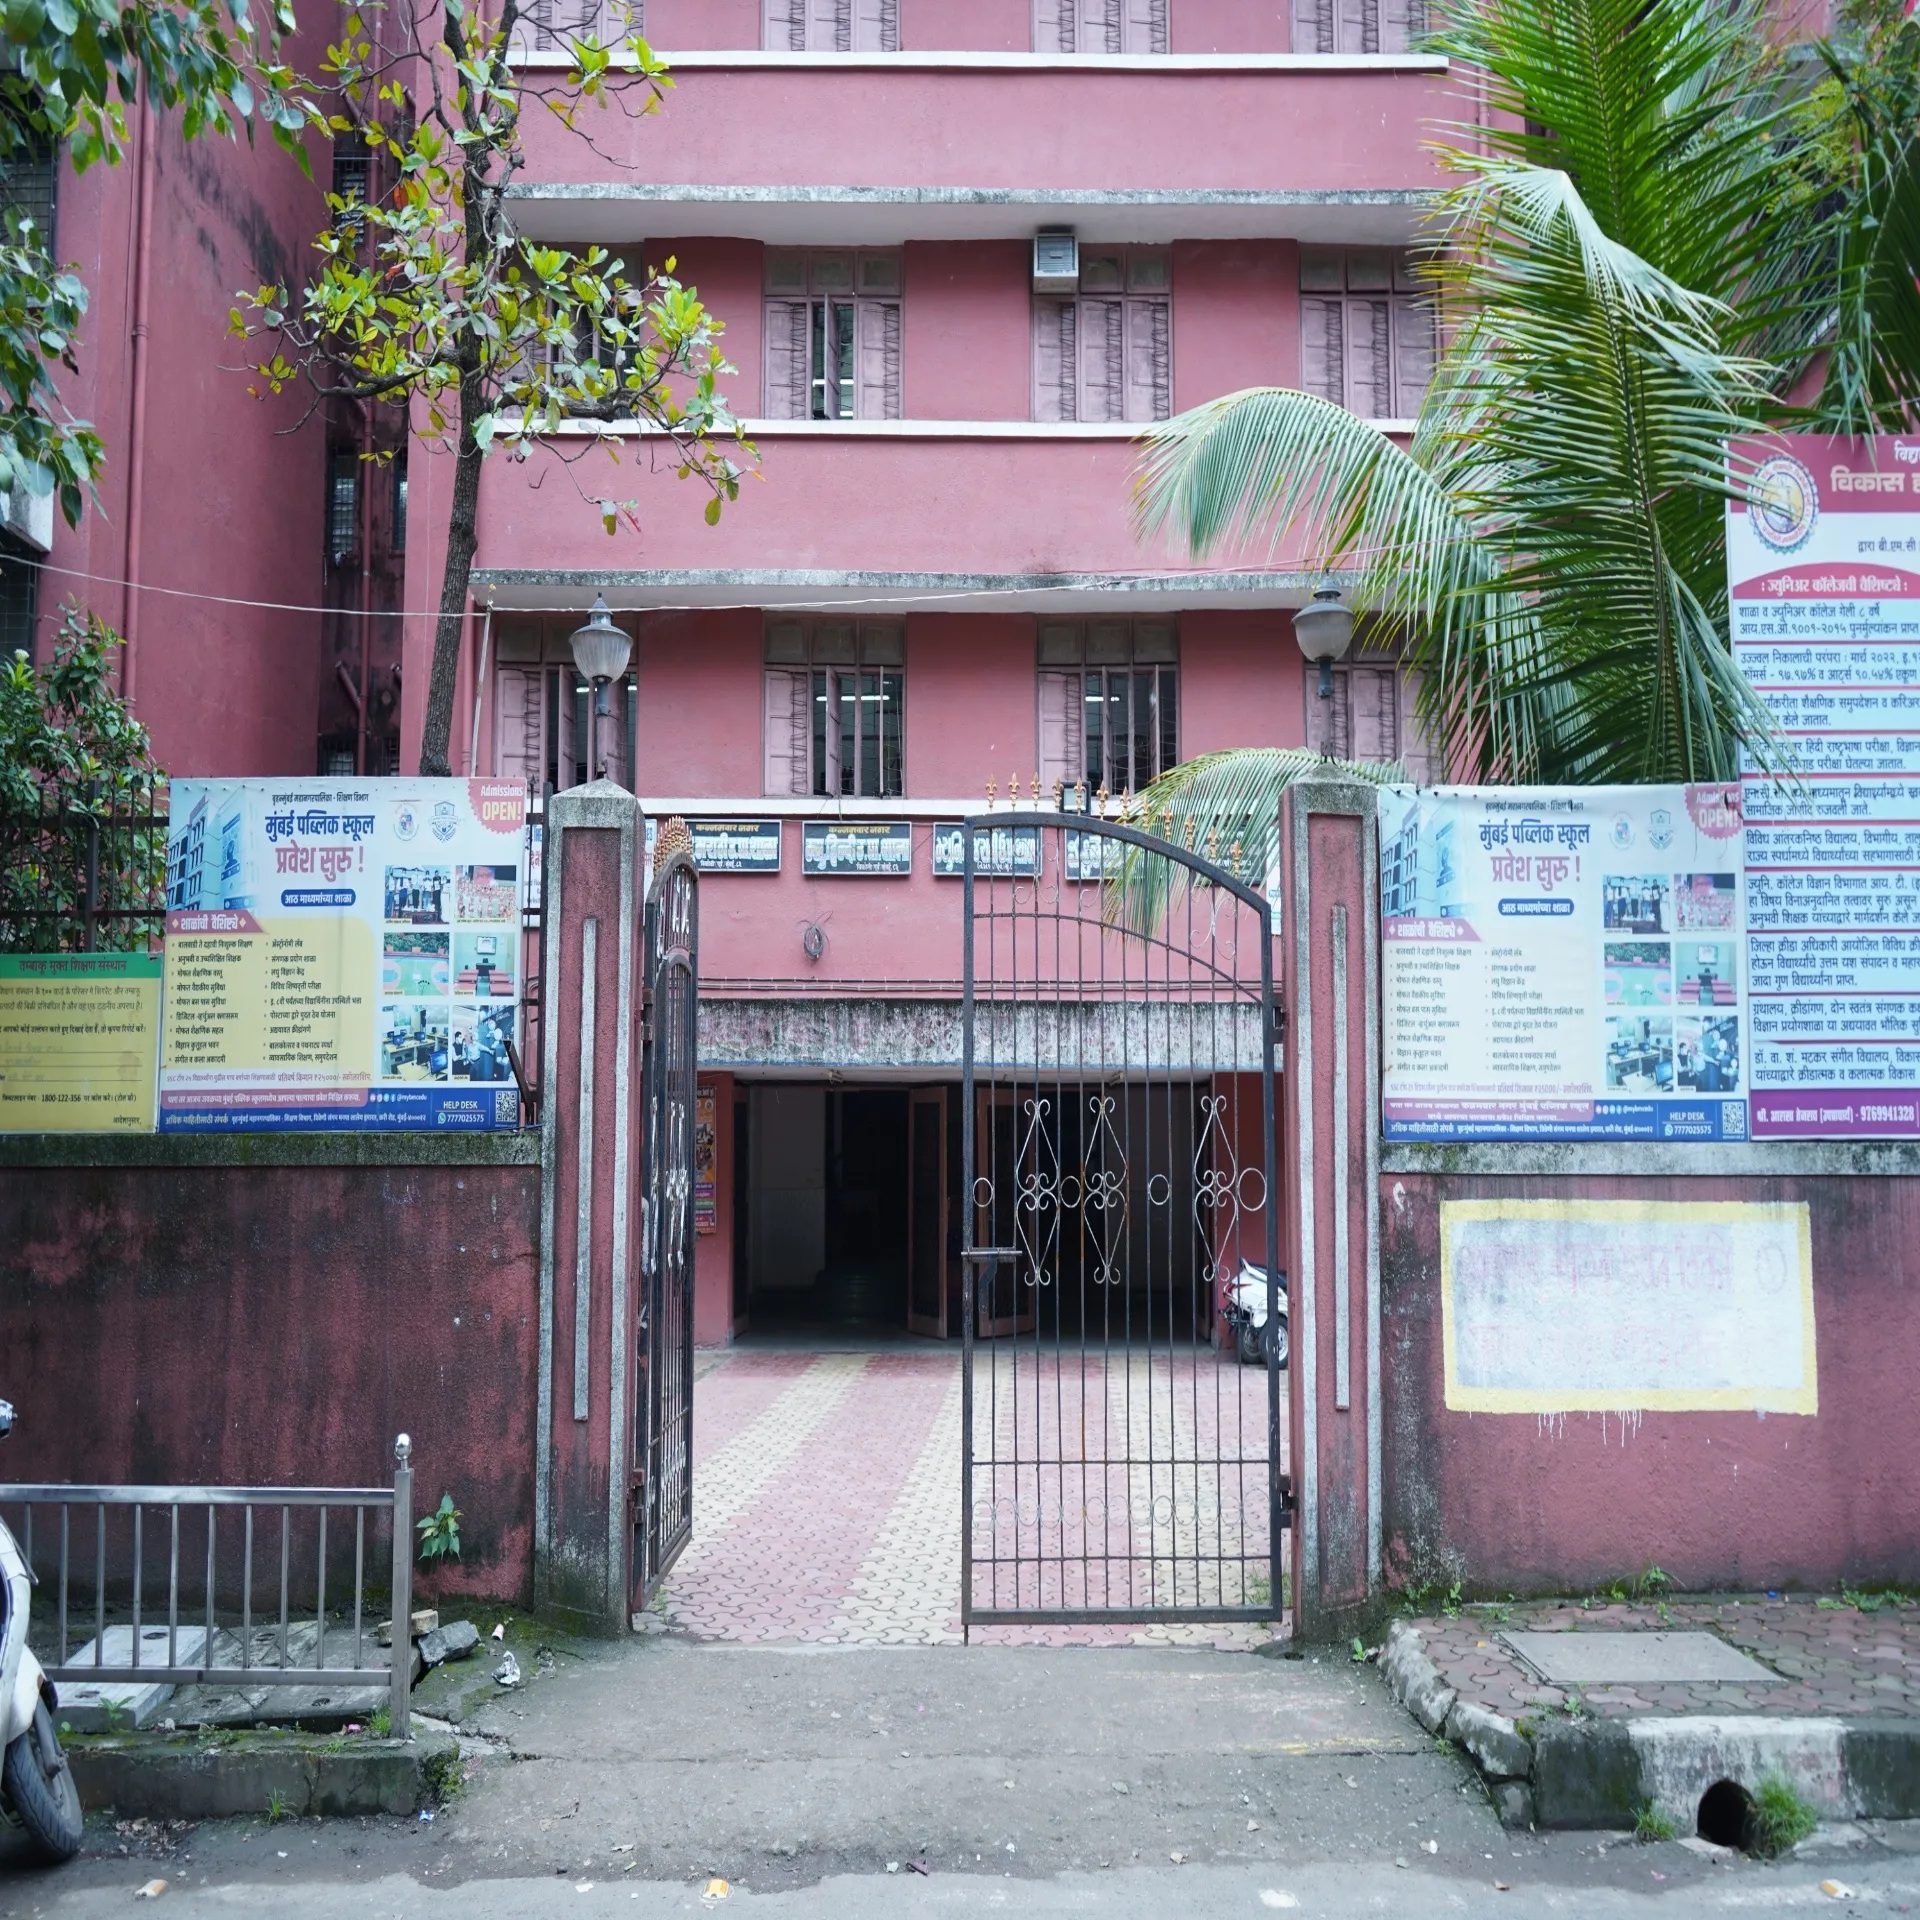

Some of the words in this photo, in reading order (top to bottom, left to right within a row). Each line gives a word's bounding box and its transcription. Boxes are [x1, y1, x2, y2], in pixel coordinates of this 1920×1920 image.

[1831, 465, 1905, 492] विकास
[1858, 540, 1875, 552] द्वारा
[1768, 575, 1809, 596] ज्युनिअर
[1739, 607, 1758, 617] शाळा
[1772, 603, 1806, 621] ज्युनिअर
[1810, 603, 1835, 617] कॉलेज
[1840, 603, 1855, 617] गेली
[1868, 602, 1880, 617] वर्षे
[1901, 623, 1919, 633] प्राप्त
[1773, 649, 1812, 663] निकालाची
[1816, 650, 1840, 662] परंपरा
[1851, 648, 1866, 662] मार्च
[1896, 669, 1916, 684] एकूण
[1802, 694, 1835, 709] शैक्षणिक
[1840, 694, 1878, 713] समुपदेशन
[1783, 712, 1799, 726] केले
[1802, 715, 1831, 726] जातात.
[1806, 738, 1823, 752] हिंदी
[1827, 742, 1862, 756] राष्ट्रभाषा
[1818, 756, 1841, 769] परीक्षा
[1845, 757, 1873, 769] घेतल्या
[1877, 759, 1906, 769] जातात.
[294, 793, 332, 802] महानगरपालिका
[337, 792, 352, 802] शिक्षण
[354, 792, 369, 802] विभाग
[481, 785, 523, 797] Admissions
[483, 802, 522, 820] OPEN!
[1745, 801, 1782, 815] सामाजिक
[1817, 801, 1851, 815] रुजवली
[1851, 801, 1871, 815] जाते.
[265, 810, 294, 842] मुंबई
[297, 810, 340, 835] पब्लिक
[342, 815, 375, 841] स्कूल
[1479, 819, 1508, 850] मुंबई
[1511, 819, 1554, 843] पब्लिक
[1557, 825, 1590, 850] स्कूल
[1747, 829, 1769, 844] विविध
[1773, 829, 1822, 844] आंतरकनिष्ठ
[275, 839, 316, 873] प्रवेश
[319, 847, 353, 882] सुरु
[359, 846, 363, 872] !
[1748, 850, 1767, 861] राज्य
[1863, 847, 1913, 862] सहभागासाठी
[1491, 848, 1532, 882] प्रवेश
[1535, 856, 1569, 891] सुरु
[1576, 856, 1580, 882] !
[1777, 875, 1803, 889] कॉलेज
[1807, 874, 1830, 889] विज्ञान
[1834, 874, 1867, 889] विभागात
[285, 895, 298, 904] आठ
[300, 892, 333, 904] माध्यमांच्या
[335, 894, 352, 903] शाळा
[1749, 895, 1757, 907] हा
[1761, 892, 1782, 906] विषय
[1786, 892, 1840, 910] विनाअनुदानित
[1895, 896, 1916, 910] असून
[1502, 903, 1515, 912] आठ
[1553, 903, 1570, 912] शाळा
[181, 914, 208, 929] शाळांची
[1750, 909, 1778, 928] अनुभवी
[1782, 909, 1808, 924] शिक्षक
[1812, 909, 1850, 925] यांच्याद्वारे
[1854, 909, 1889, 923] मार्गदर्शन
[1893, 909, 1908, 923] केले
[1751, 937, 1774, 952] जिल्हा
[1778, 937, 1797, 952] क्रीडा
[1801, 936, 1837, 951] अधिकारी
[1842, 936, 1879, 951] आयोजित
[1882, 936, 1905, 951] विविध
[71, 957, 95, 971] शिक्षण
[98, 957, 127, 971] संस्थान
[1751, 954, 1773, 969] होऊन
[1777, 953, 1816, 969] विद्यार्थ्यांचे
[1820, 958, 1838, 968] उत्तम
[1842, 958, 1857, 968] यश
[1861, 954, 1888, 968] संपादन
[1752, 975, 1771, 986] जादा
[1775, 975, 1788, 991] गुण
[1792, 971, 1833, 986] विद्यार्थ्यांना
[1831, 1000, 1845, 1014] दोन
[1849, 1000, 1872, 1014] स्वतंत्र
[1876, 999, 1905, 1014] संगणक
[1754, 1016, 1777, 1032] विज्ञान
[1781, 1016, 1823, 1032] प्रयोगशाळा
[1827, 1020, 1837, 1031] या
[1881, 1016, 1907, 1031] भौतिक
[1754, 1048, 1766, 1063] डॉ.
[1771, 1052, 1782, 1063] वा.
[1801, 1052, 1826, 1063] मटकर
[1830, 1048, 1853, 1062] संगीत
[1756, 1066, 1794, 1082] यांच्याद्वारे
[1798, 1065, 1836, 1081] क्रीडात्मक
[1848, 1069, 1885, 1080] कलात्मक
[1889, 1064, 1916, 1079] विकास
[444, 1101, 459, 1109] HELP
[448, 1114, 484, 1122] 7777025575
[1670, 1112, 1686, 1120] HELP
[1688, 1112, 1704, 1120] DESK
[1861, 1105, 1914, 1121] 9769941328
[1674, 1126, 1711, 1134] 7777025575
